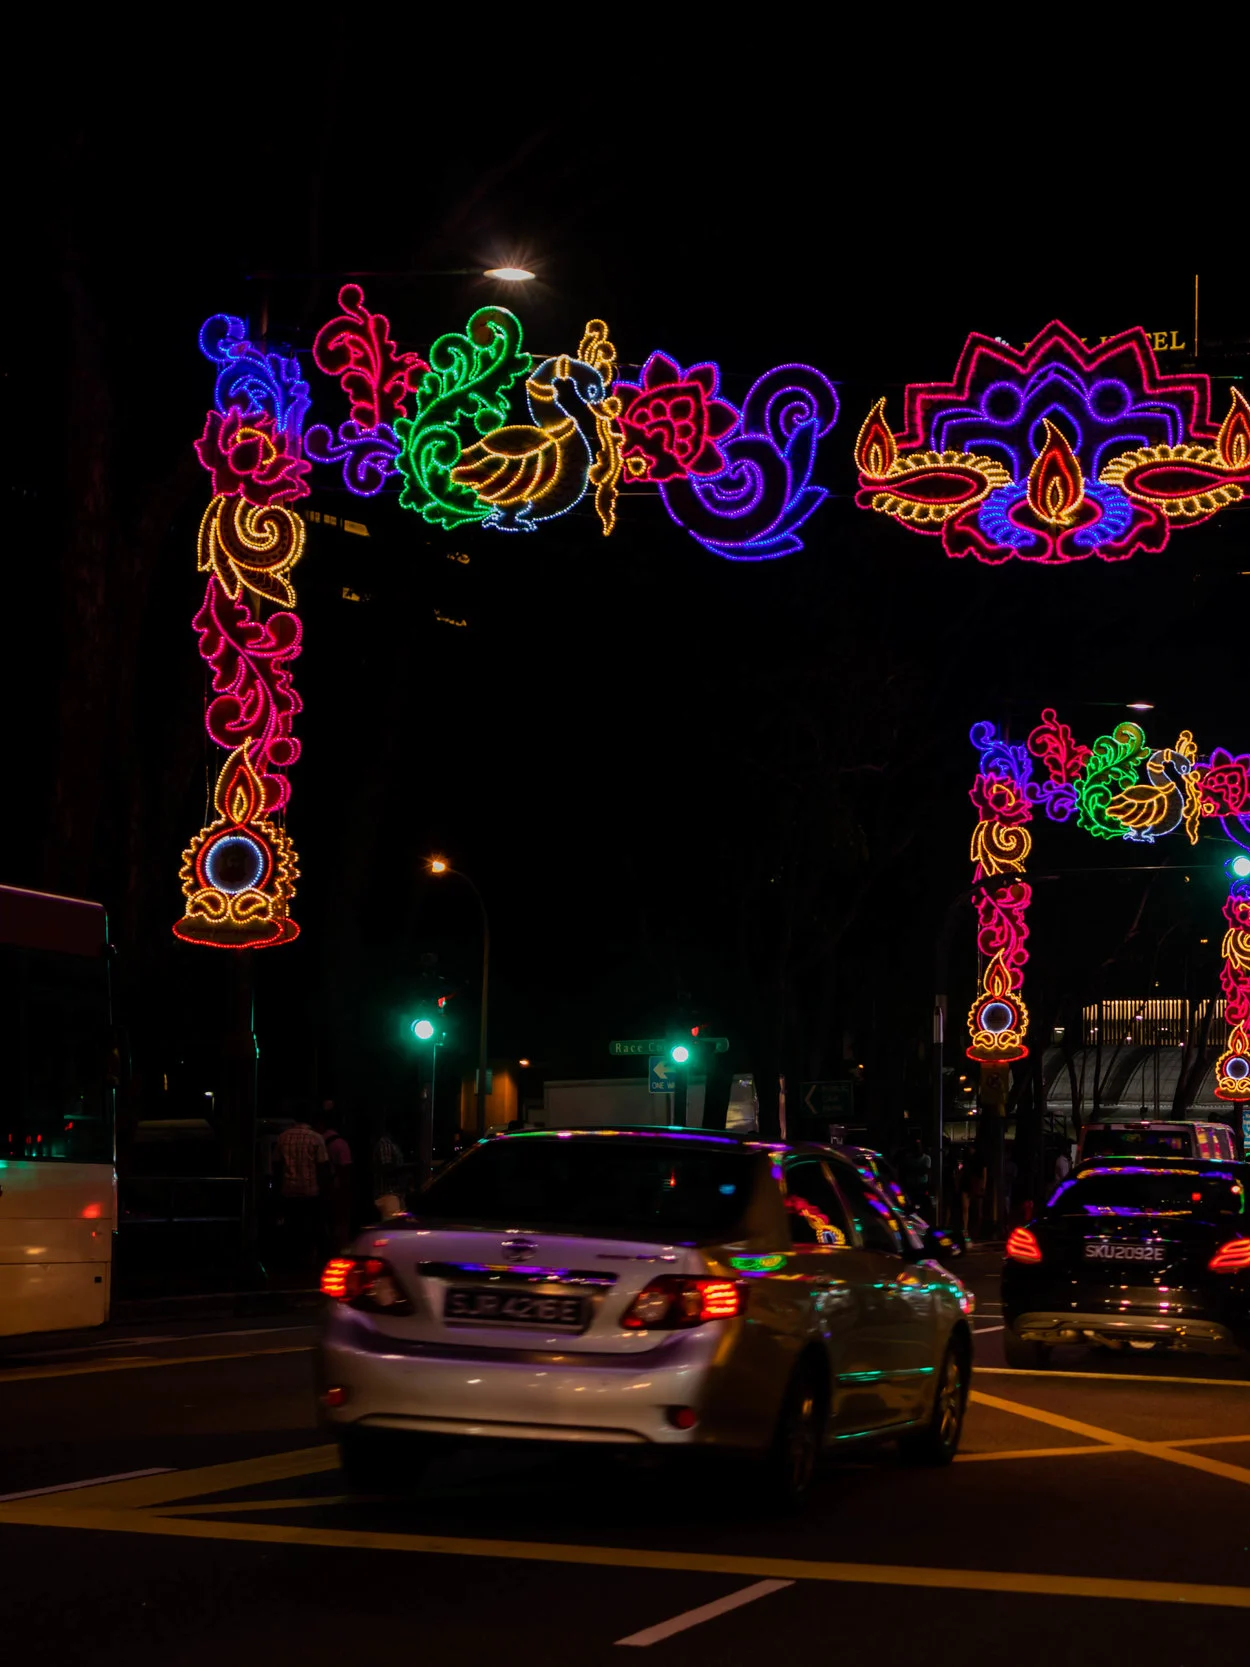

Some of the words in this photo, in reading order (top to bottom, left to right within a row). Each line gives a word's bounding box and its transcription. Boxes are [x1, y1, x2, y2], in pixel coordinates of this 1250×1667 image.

[615, 1042, 643, 1053] Race
[652, 1081, 665, 1090] ONE
[1084, 1244, 1165, 1261] SKU2092E
